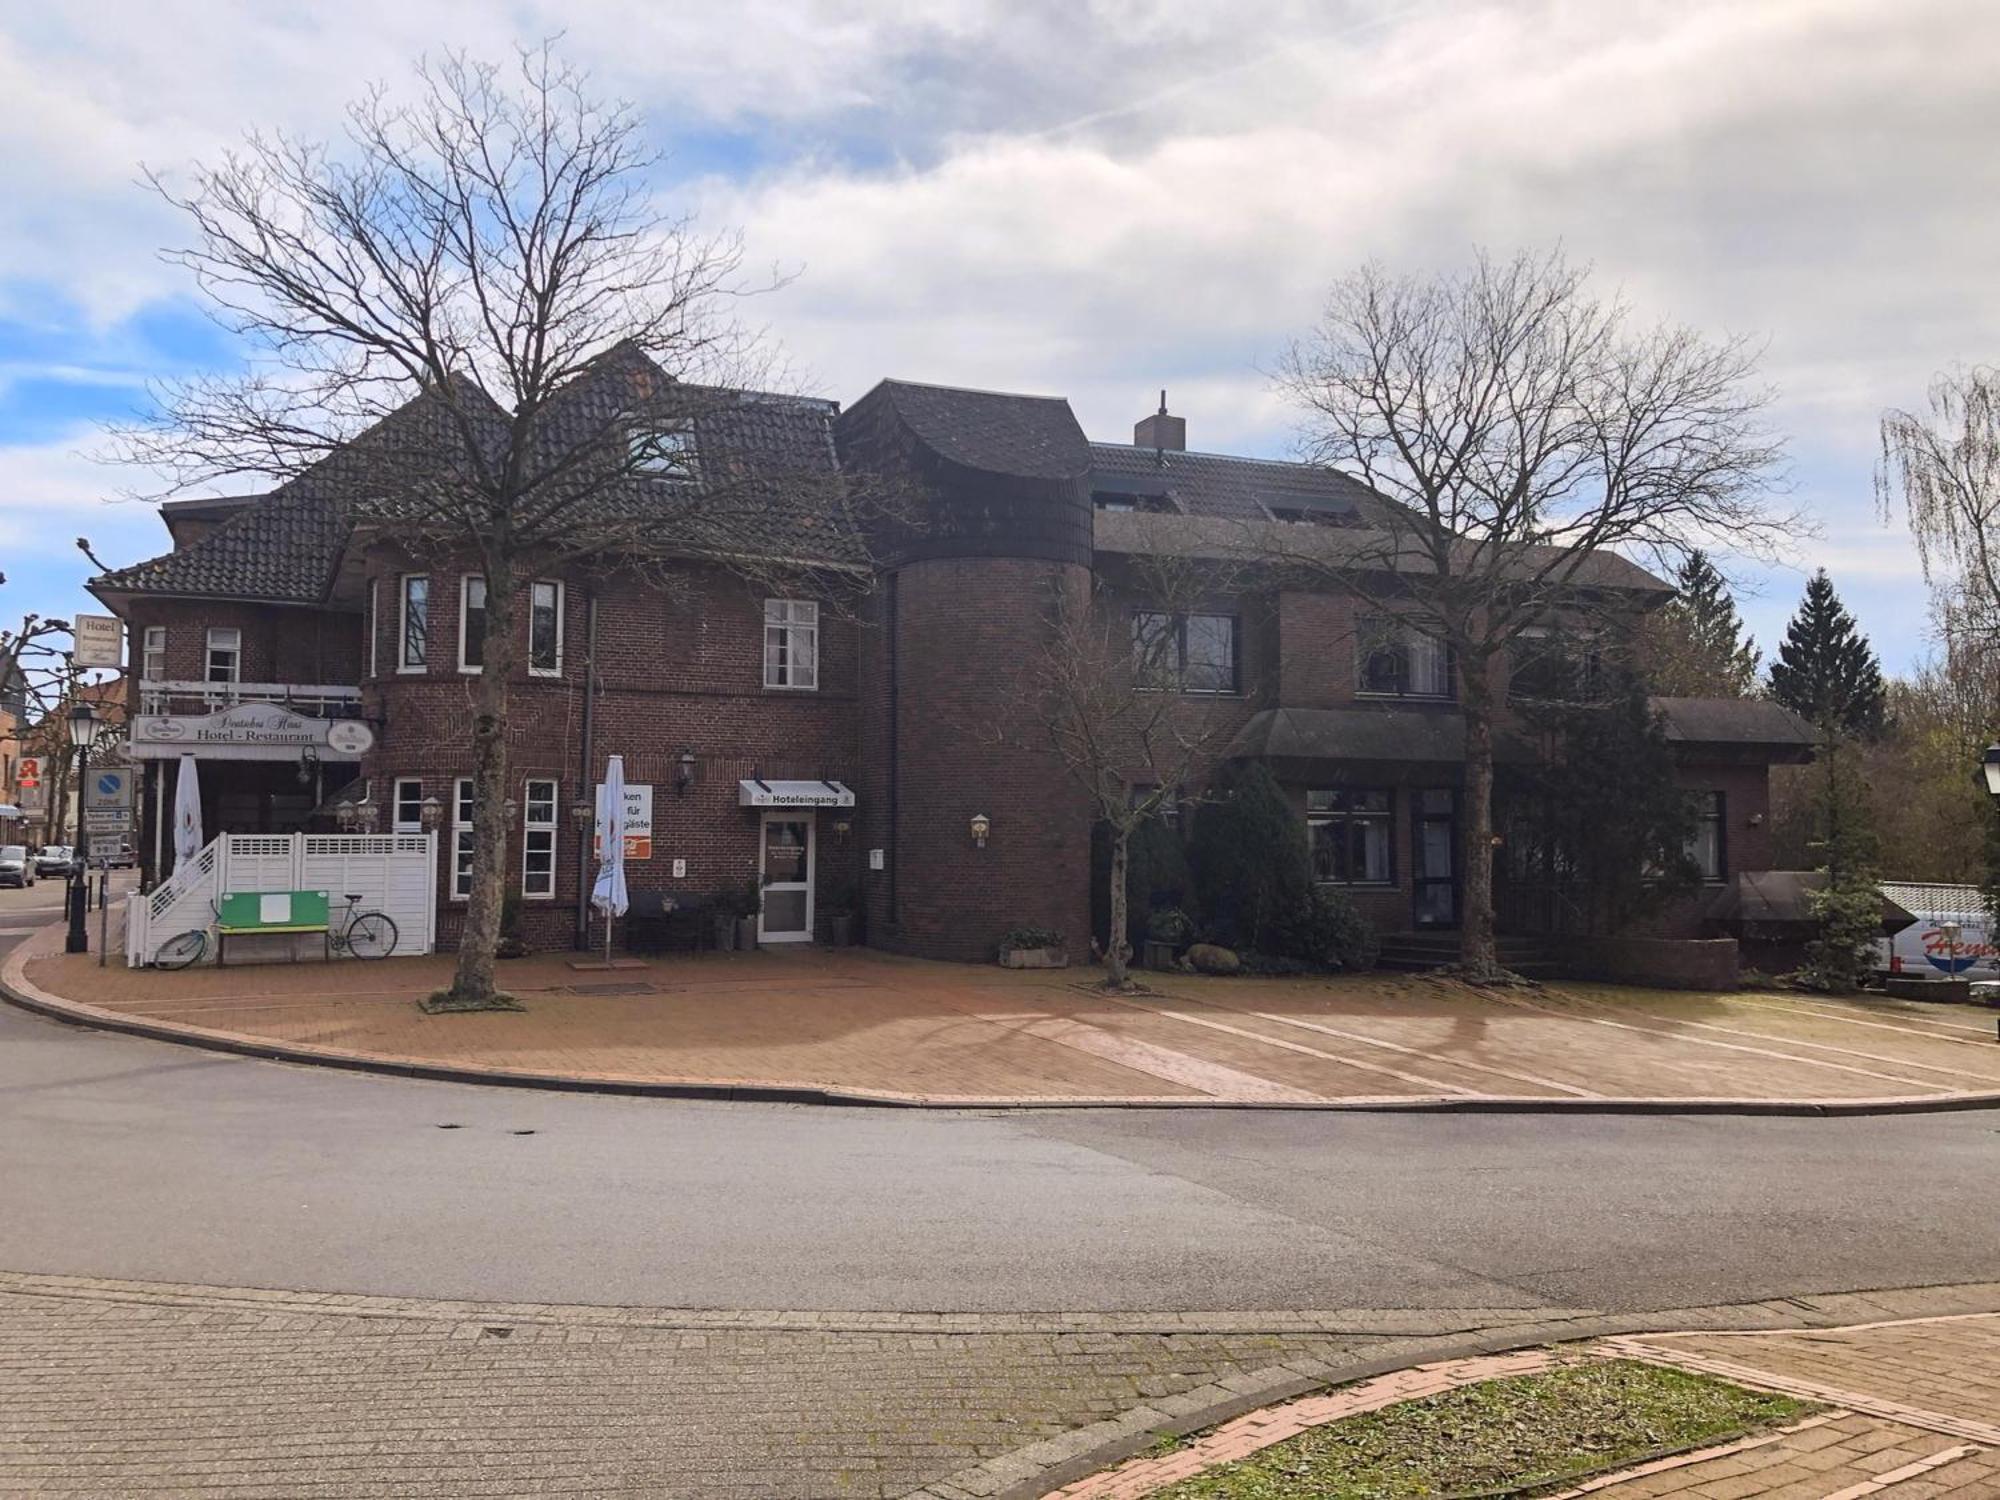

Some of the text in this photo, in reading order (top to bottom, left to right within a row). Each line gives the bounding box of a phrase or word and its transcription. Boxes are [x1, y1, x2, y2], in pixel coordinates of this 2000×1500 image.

[86, 620, 115, 632] Hotel
[197, 730, 234, 741] Hotel
[246, 730, 314, 742] Restaurant
[772, 794, 839, 806] Hoteleingang
[627, 806, 641, 816] für
